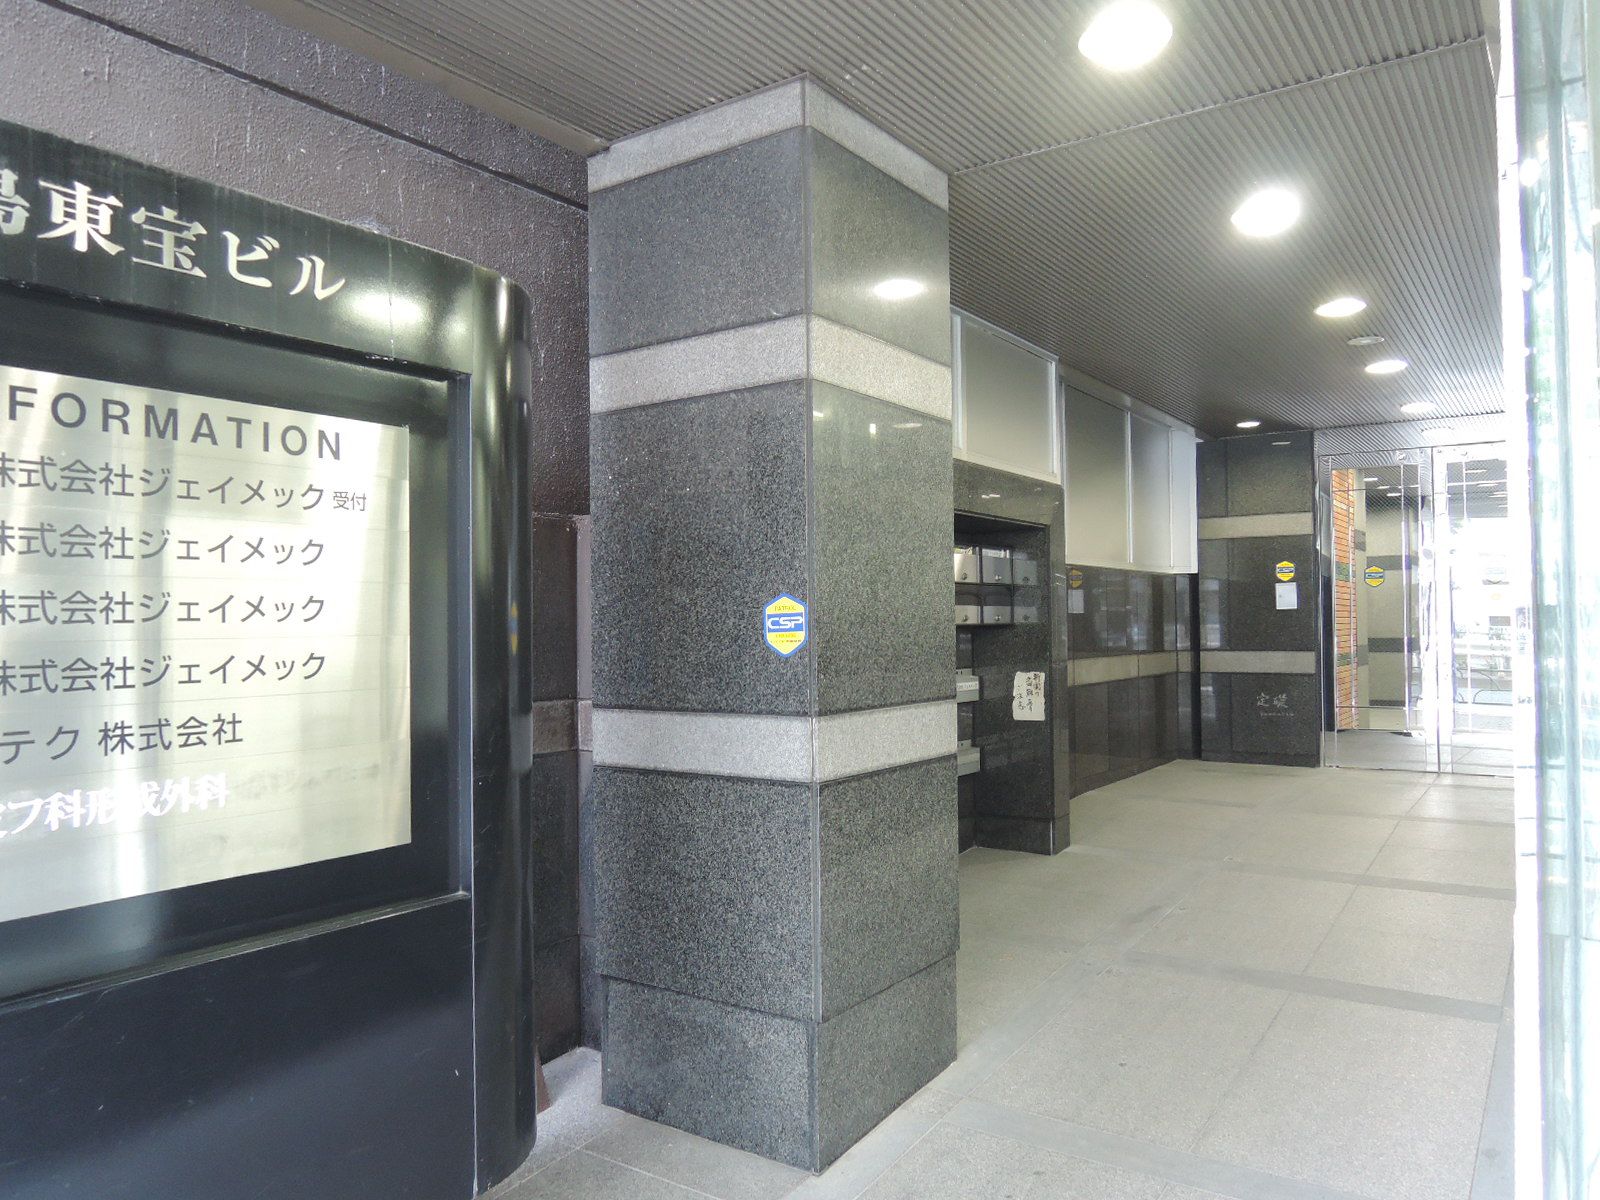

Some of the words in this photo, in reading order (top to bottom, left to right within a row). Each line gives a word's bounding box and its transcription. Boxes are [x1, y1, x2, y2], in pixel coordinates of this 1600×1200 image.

[8, 384, 341, 461] FORMATION
[332, 490, 367, 512] 受付
[767, 616, 803, 630] CSP
[98, 712, 244, 757] 株式会社
[0, 772, 230, 839] フ科形成外科
